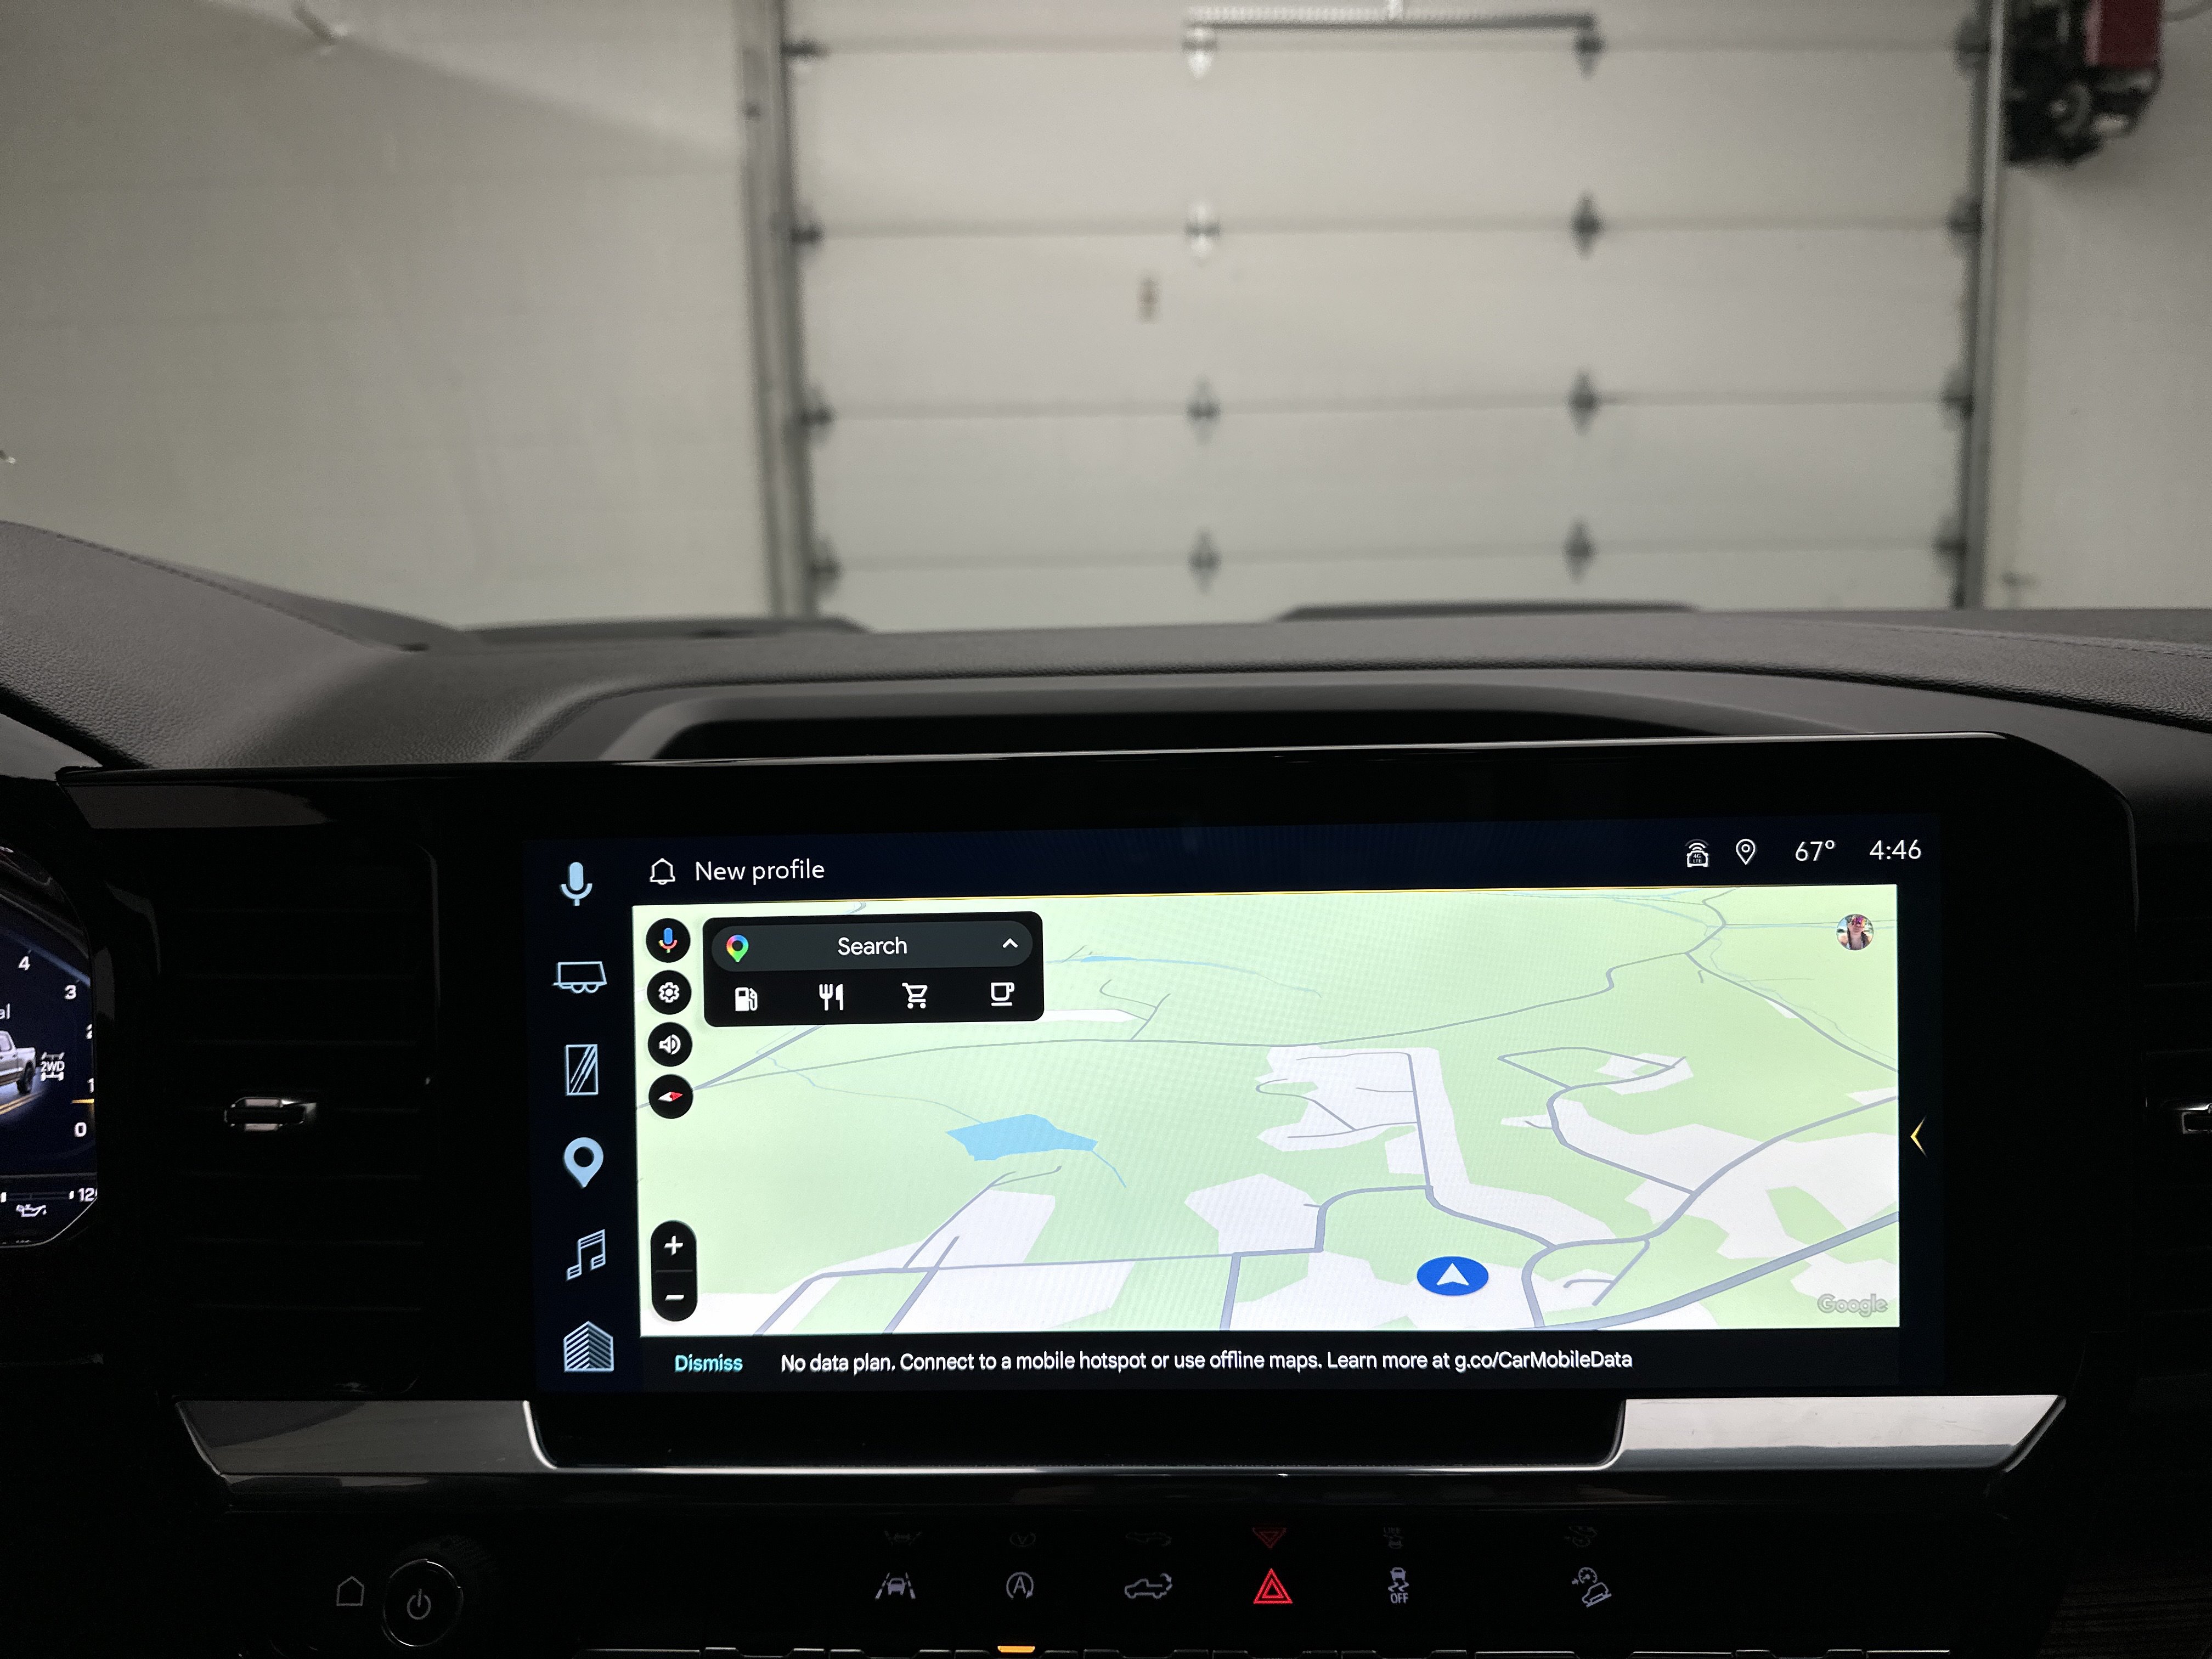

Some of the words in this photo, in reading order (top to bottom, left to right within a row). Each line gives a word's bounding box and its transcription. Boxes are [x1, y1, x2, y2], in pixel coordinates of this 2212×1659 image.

[1795, 839, 1835, 862] 67°
[1869, 839, 1921, 860] 4:46
[696, 861, 746, 881] New
[753, 858, 825, 885] profile
[838, 936, 907, 956] Search
[18, 956, 31, 971] 4
[64, 984, 77, 1000] 3
[40, 1060, 65, 1073] 2WD
[74, 1122, 87, 1137] 0
[77, 1187, 98, 1203] 12
[1817, 1293, 1888, 1318] Google
[674, 1353, 743, 1373] Dismiss
[781, 1353, 806, 1372] No
[809, 1353, 849, 1372] data
[853, 1353, 896, 1376] plan.
[900, 1353, 974, 1371] Connect
[978, 1353, 997, 1370] to
[1001, 1356, 1012, 1370] a
[1017, 1351, 1075, 1370] mobile
[1080, 1350, 1147, 1374] hotspot
[1151, 1355, 1170, 1369] or
[1174, 1355, 1205, 1369] use
[1209, 1350, 1265, 1369] offline
[1269, 1355, 1323, 1373] maps.
[1327, 1351, 1378, 1369] Learn
[1383, 1355, 1428, 1369] more
[1432, 1352, 1451, 1369] at
[1454, 1350, 1633, 1373] g.co/CarMobileData
[1390, 1592, 1409, 1604] OFF
